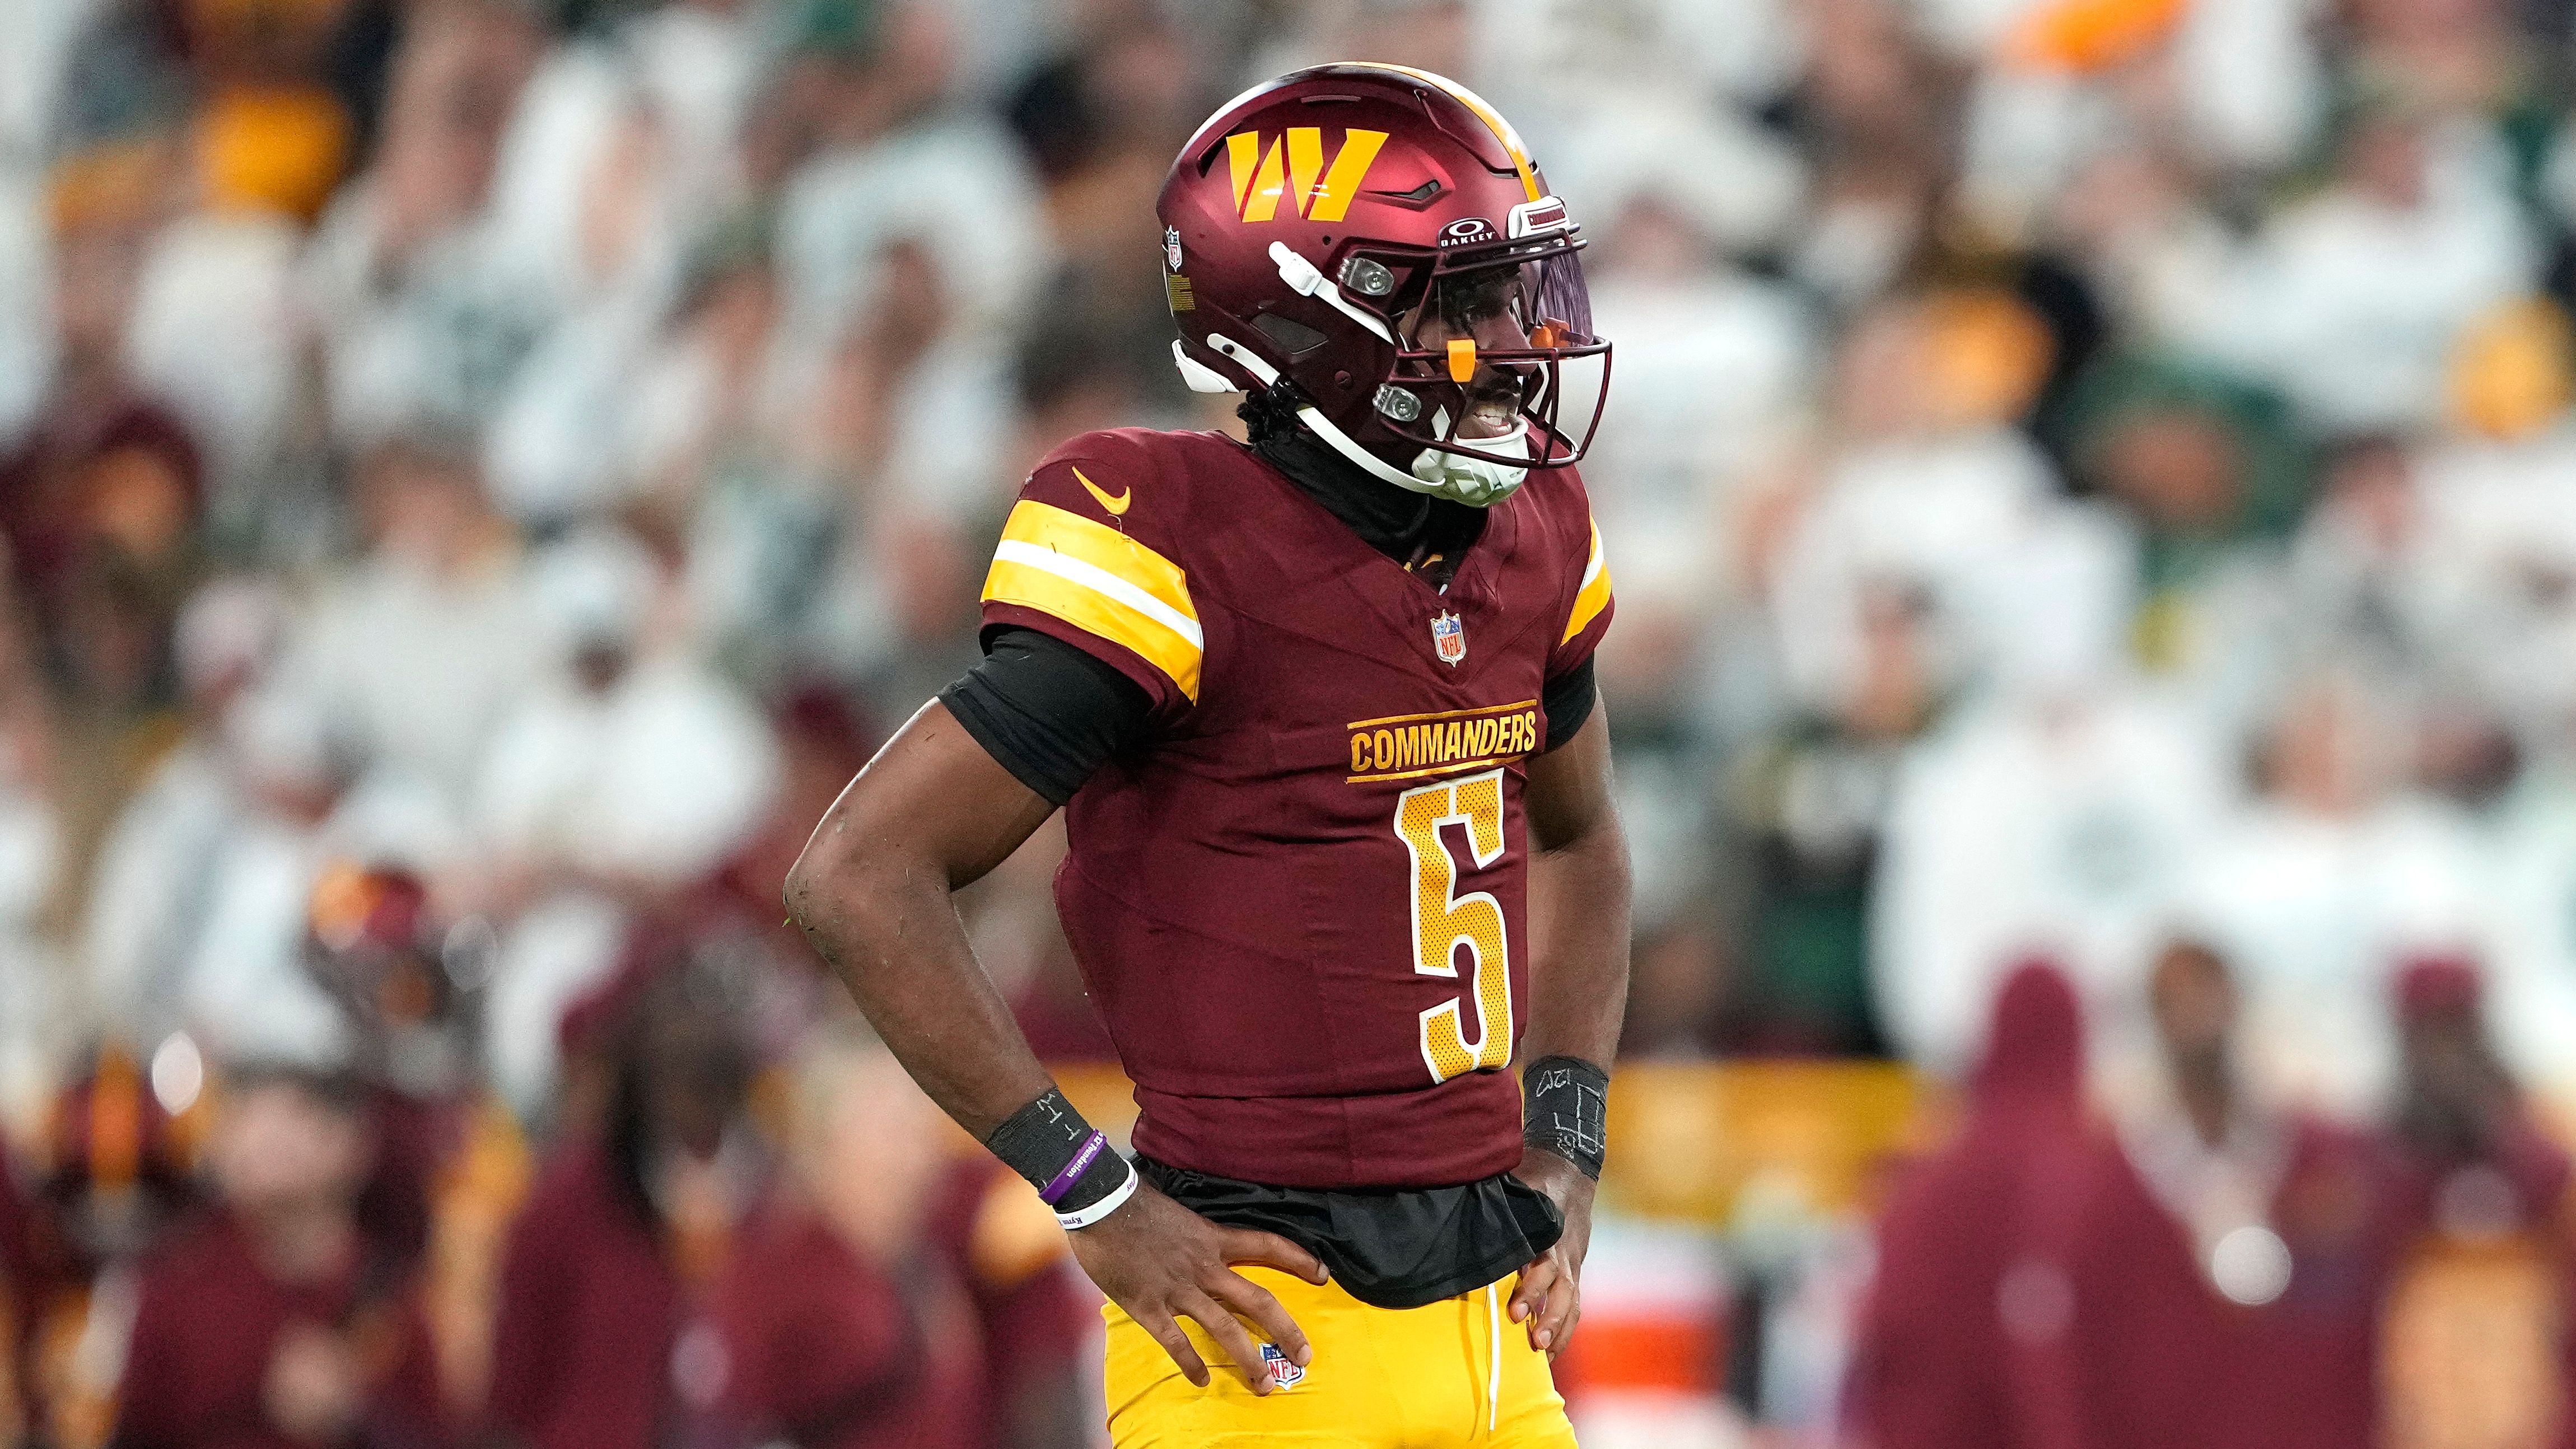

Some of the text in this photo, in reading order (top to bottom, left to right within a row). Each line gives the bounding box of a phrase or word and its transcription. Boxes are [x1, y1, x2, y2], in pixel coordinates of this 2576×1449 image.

[1226, 127, 1390, 222] W
[1441, 232, 1494, 247] OAKLEY
[1439, 635, 1462, 657] NFL
[1350, 711, 1536, 772] COMMANDERS
[1393, 768, 1513, 1085] 5
[1066, 1143, 1098, 1177] Foundation
[1268, 1359, 1298, 1380] NFL
